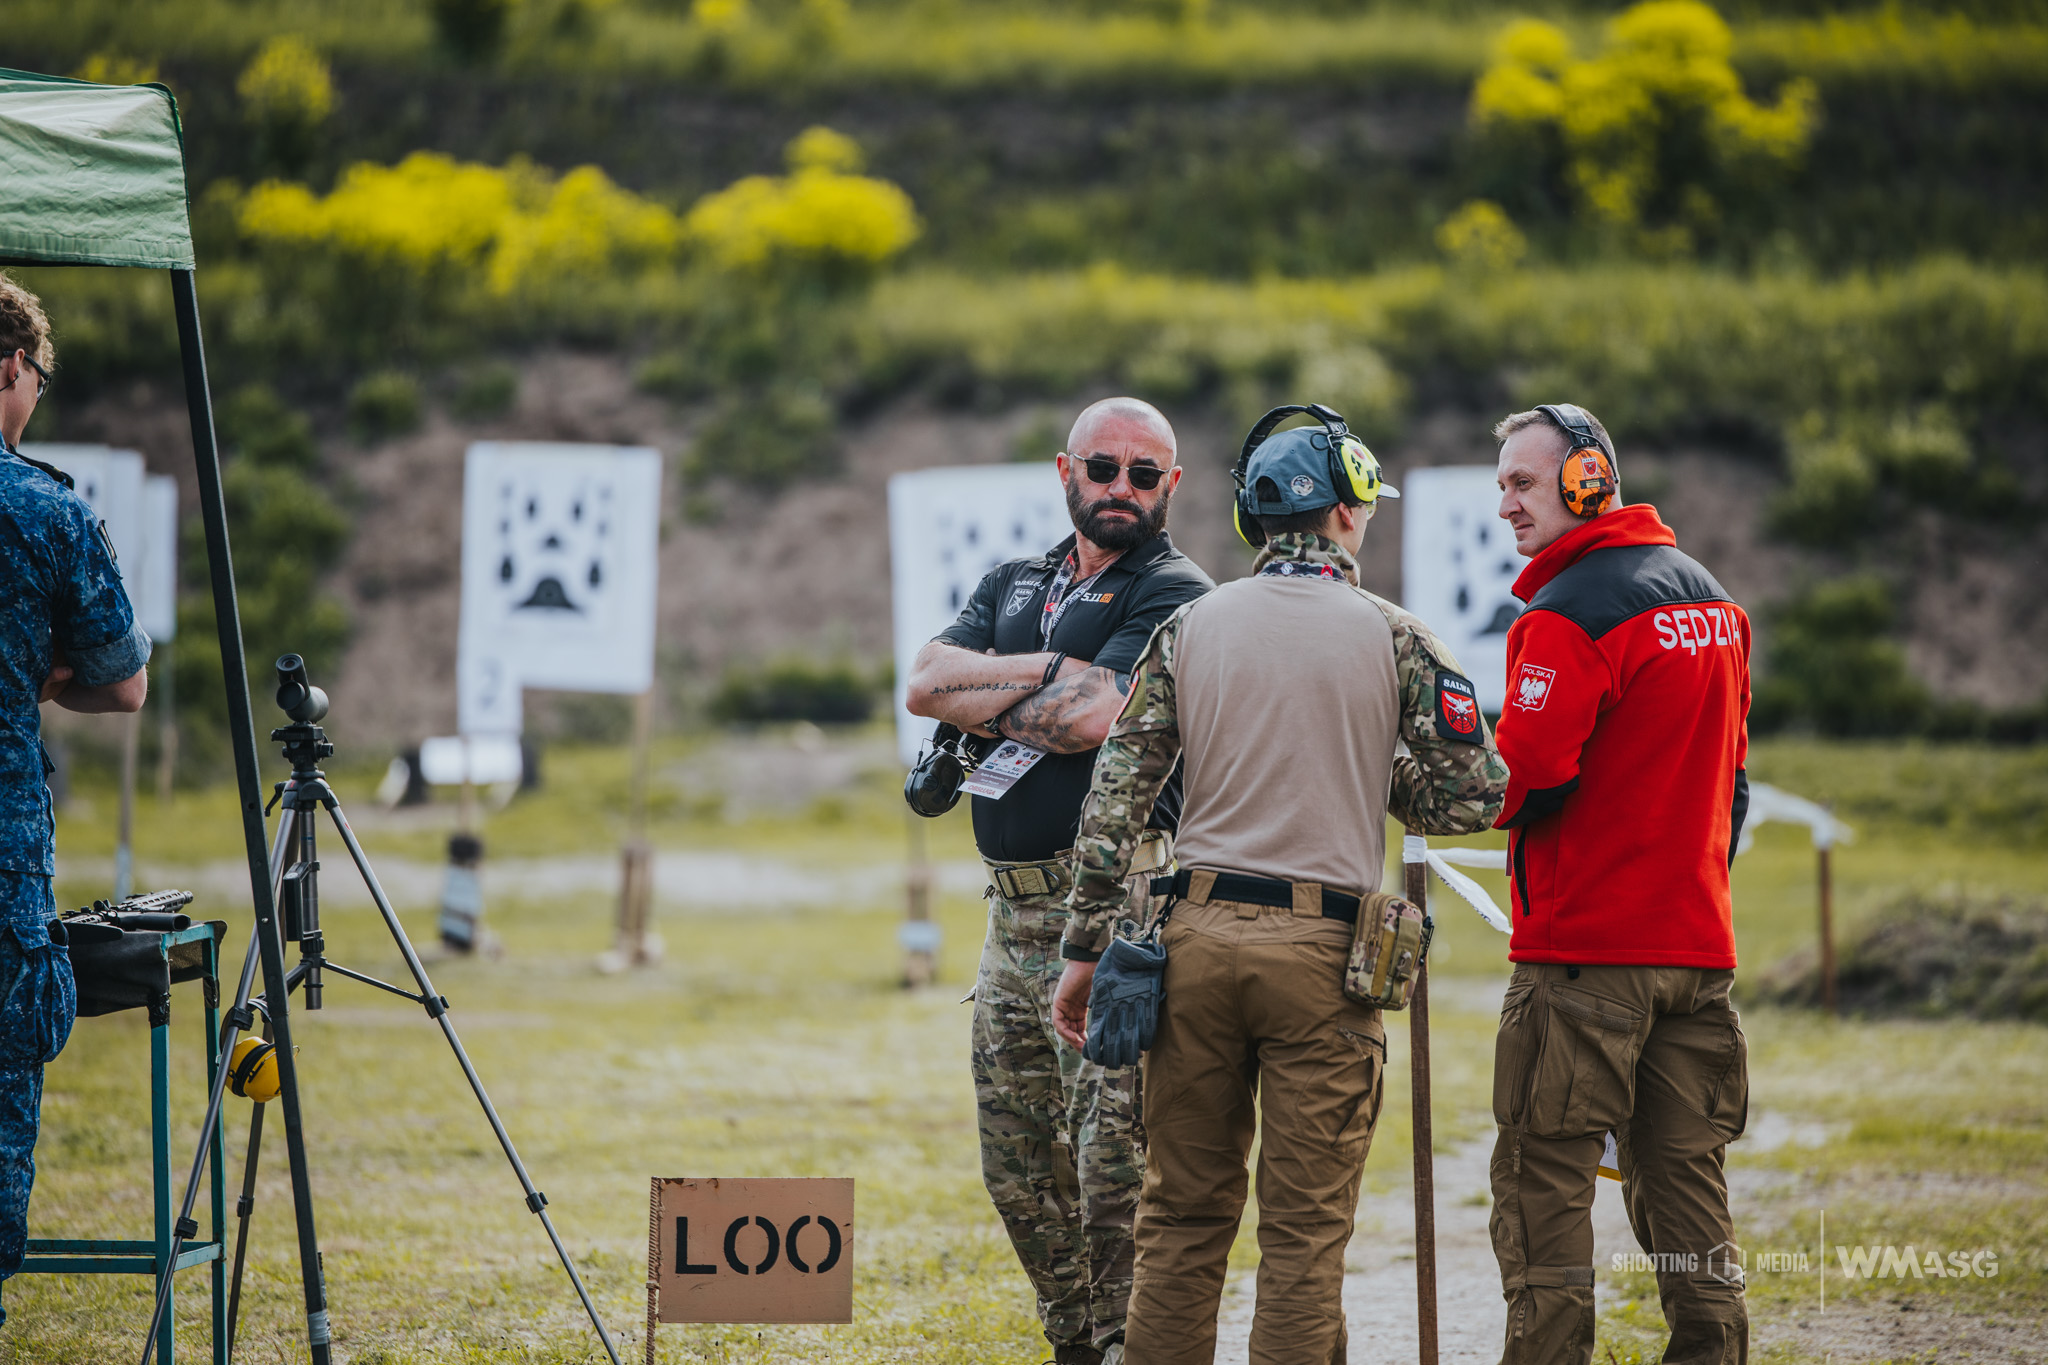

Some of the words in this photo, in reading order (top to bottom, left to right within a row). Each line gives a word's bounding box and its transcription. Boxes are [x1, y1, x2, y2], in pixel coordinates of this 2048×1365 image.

[1653, 607, 1742, 656] SĘDZIA
[1523, 667, 1551, 680] POLSKA
[1443, 678, 1472, 695] SALWA
